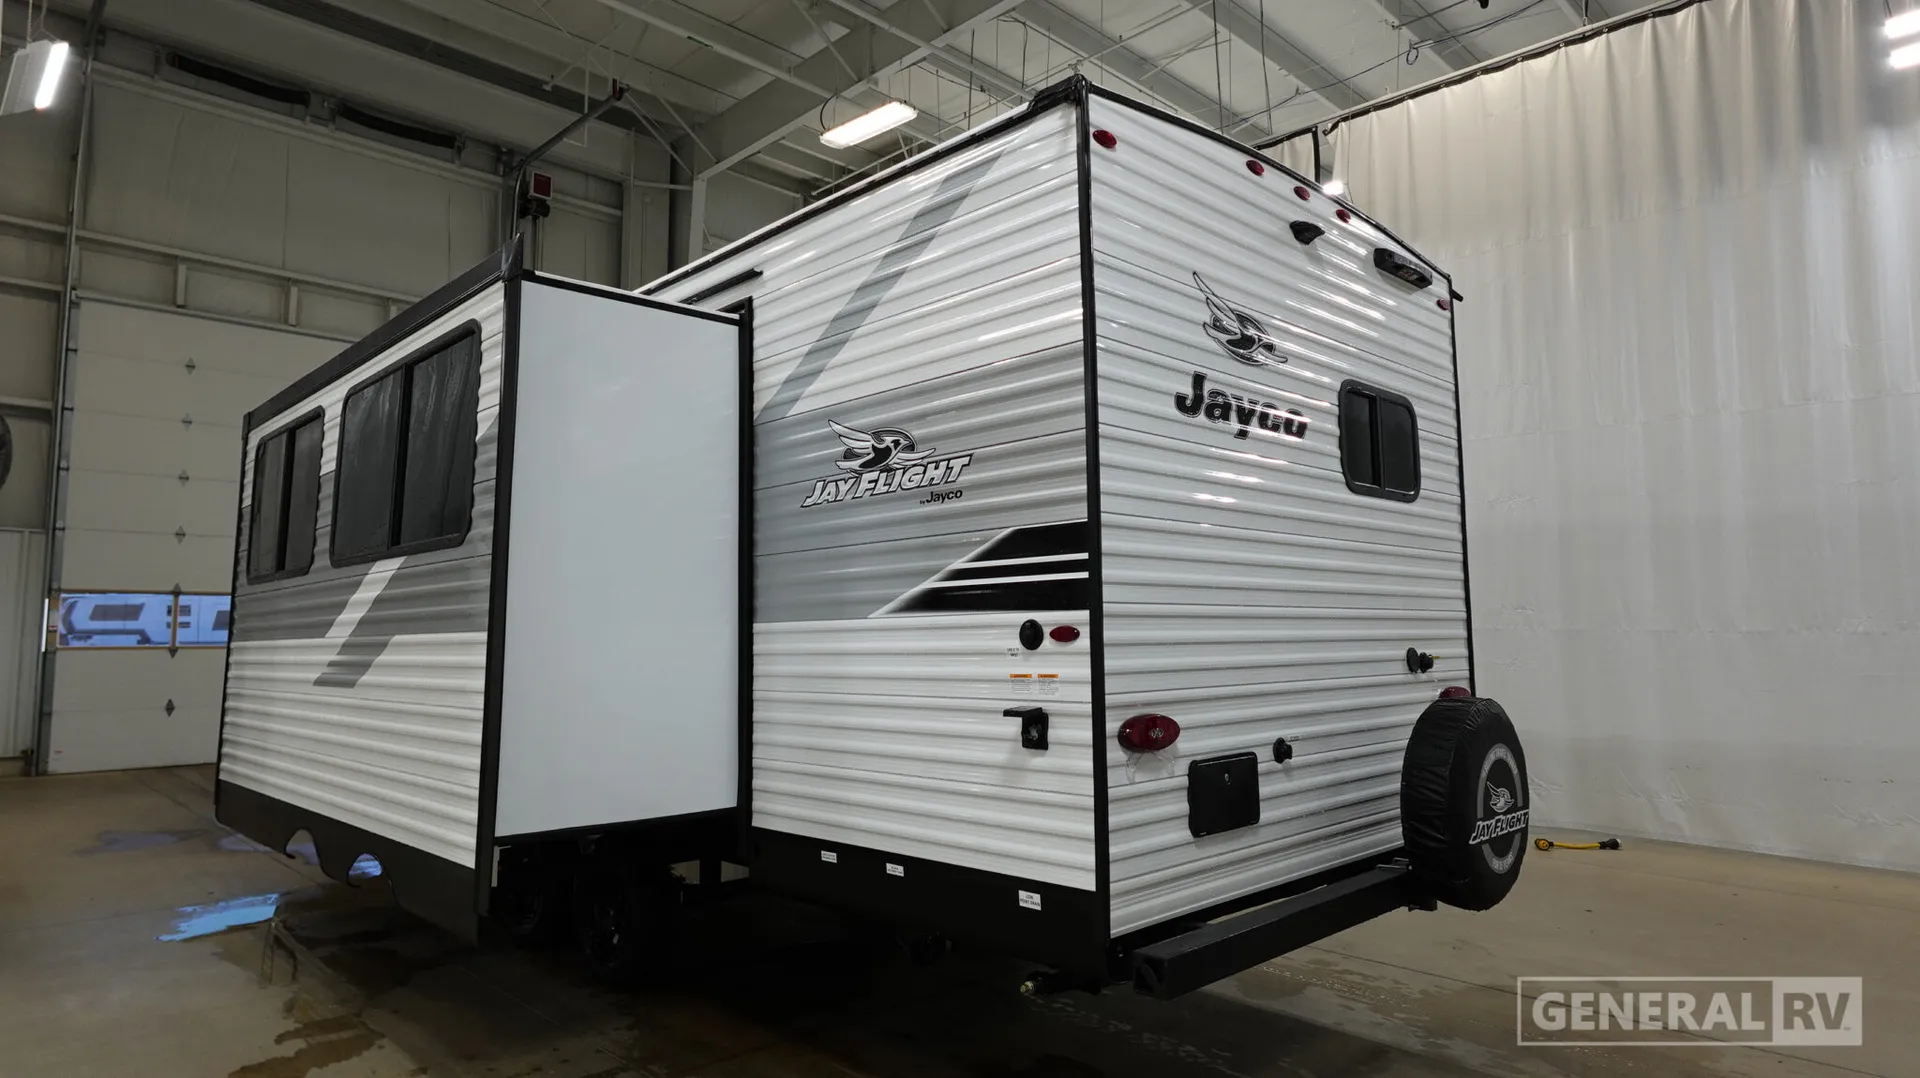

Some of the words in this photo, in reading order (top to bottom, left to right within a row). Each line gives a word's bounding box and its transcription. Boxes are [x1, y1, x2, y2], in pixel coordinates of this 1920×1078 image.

[1174, 370, 1309, 440] Jayco
[800, 476, 858, 508] JAY
[853, 453, 974, 498] FLIGHT
[925, 489, 963, 505] Jayco
[1469, 820, 1497, 845] JAY
[1491, 809, 1529, 836] FLIGHT
